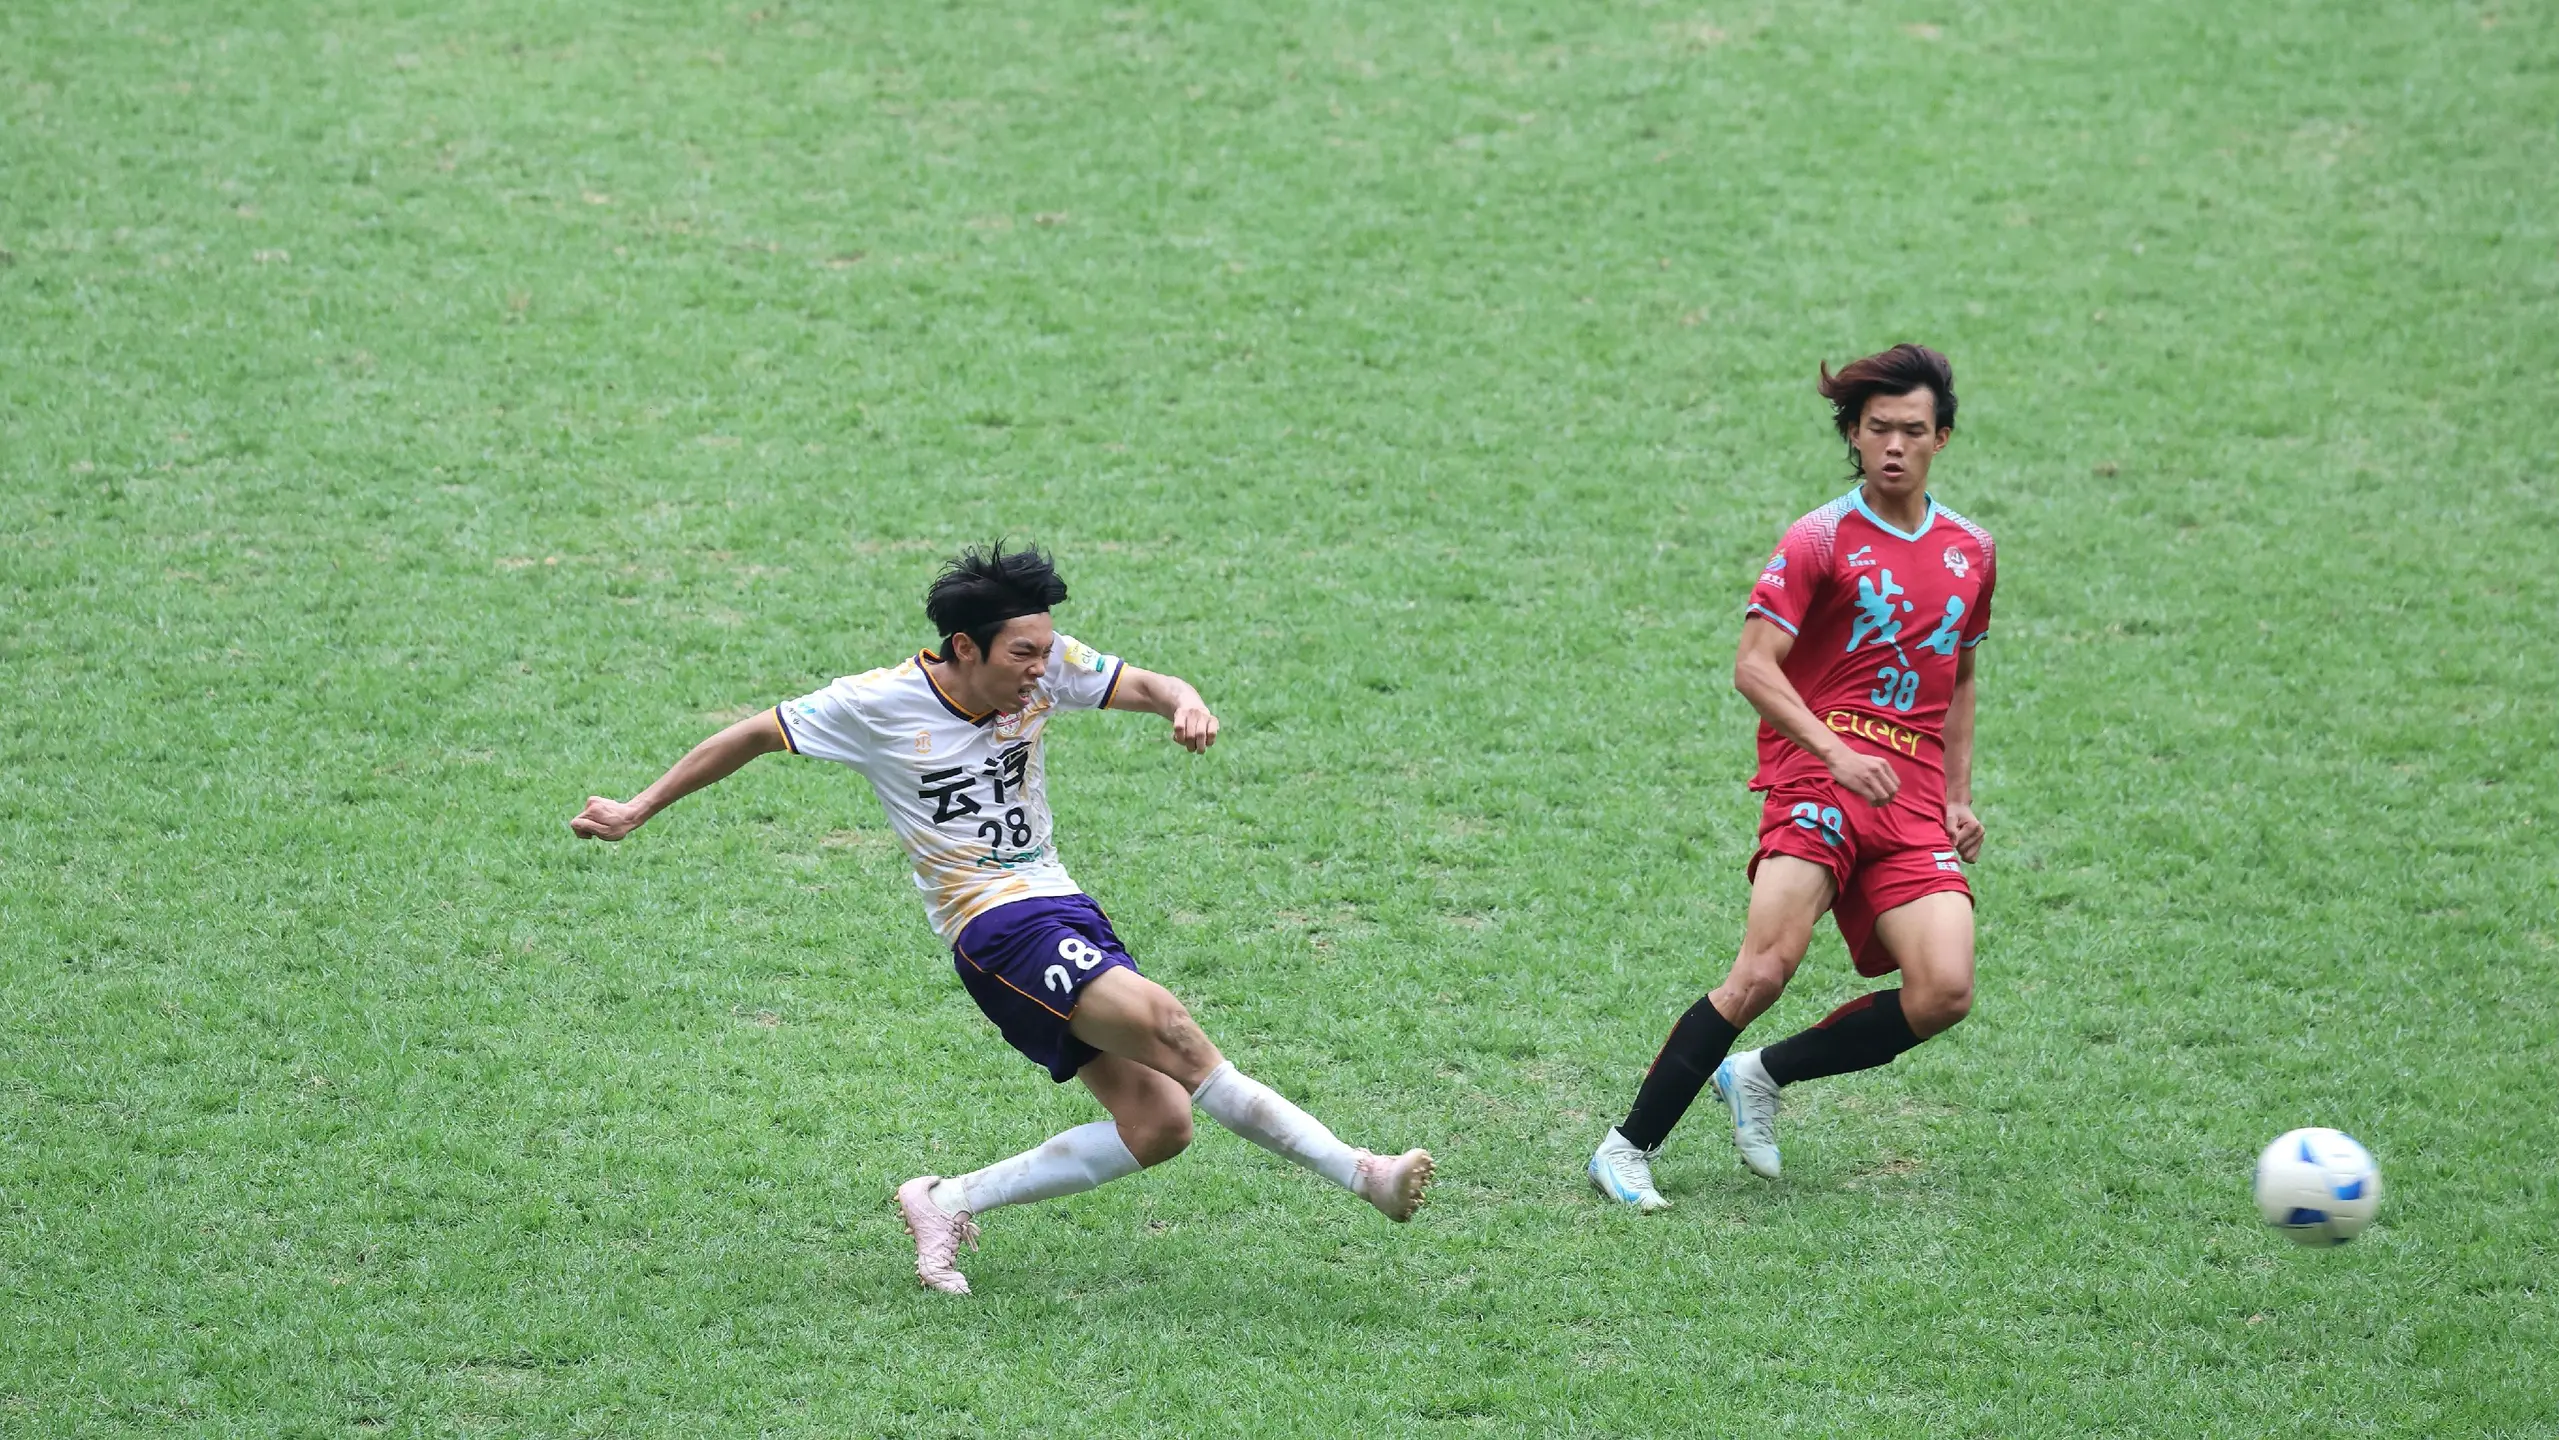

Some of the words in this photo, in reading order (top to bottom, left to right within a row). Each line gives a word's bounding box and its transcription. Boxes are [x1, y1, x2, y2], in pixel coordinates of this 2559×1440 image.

[1846, 568, 1966, 667] 茂名
[1870, 666, 1920, 712] 38
[978, 806, 1032, 851] 28
[1044, 937, 1103, 994] 28
